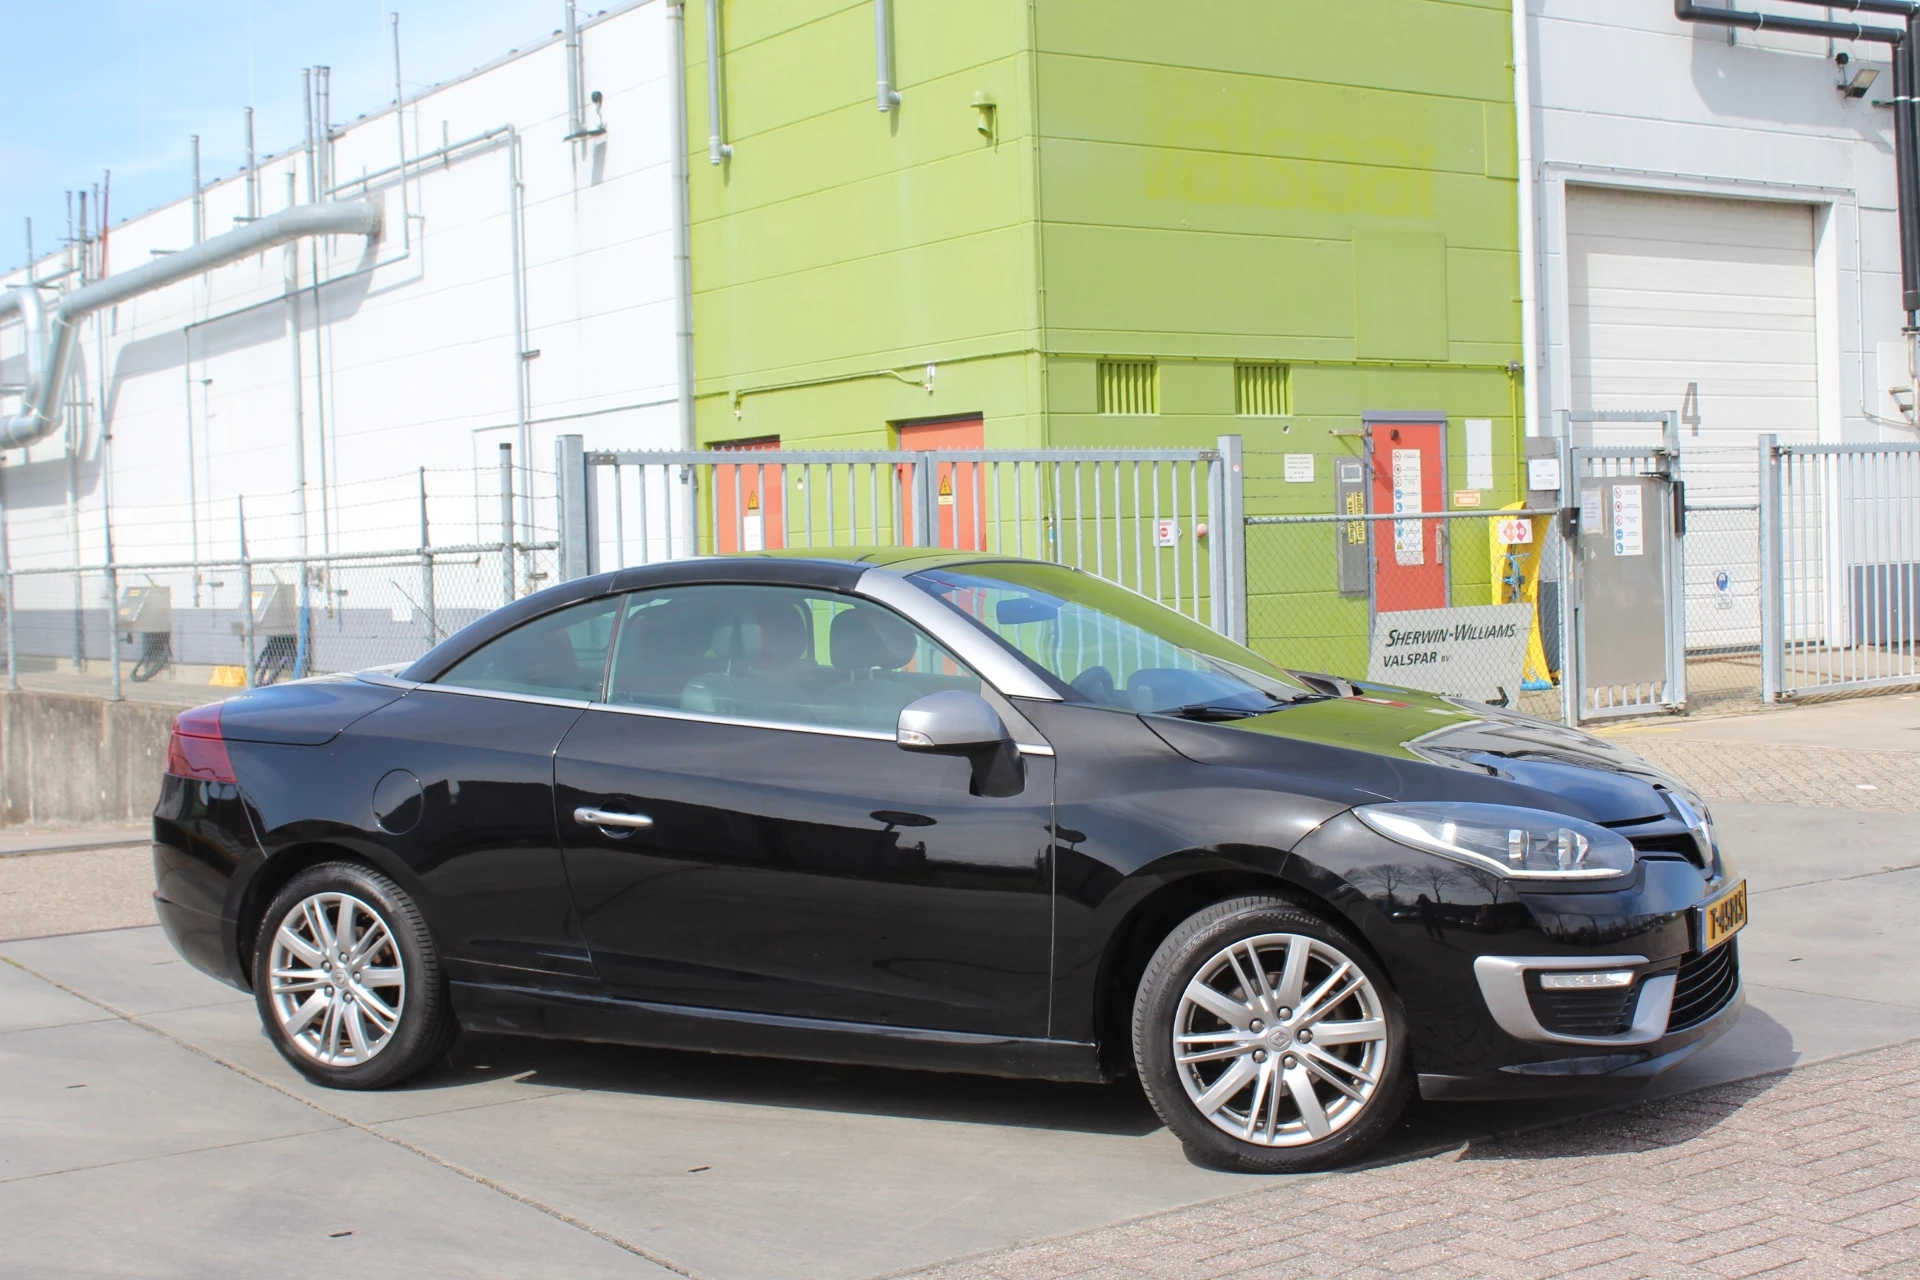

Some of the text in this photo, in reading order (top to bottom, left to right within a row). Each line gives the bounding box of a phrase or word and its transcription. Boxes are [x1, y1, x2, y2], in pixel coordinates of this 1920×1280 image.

[1682, 382, 1701, 437] 4
[1356, 491, 1364, 544] Tankagen
[1386, 624, 1516, 647] SHERWIN-WILLIAMS
[1383, 651, 1437, 667] VALSPAR
